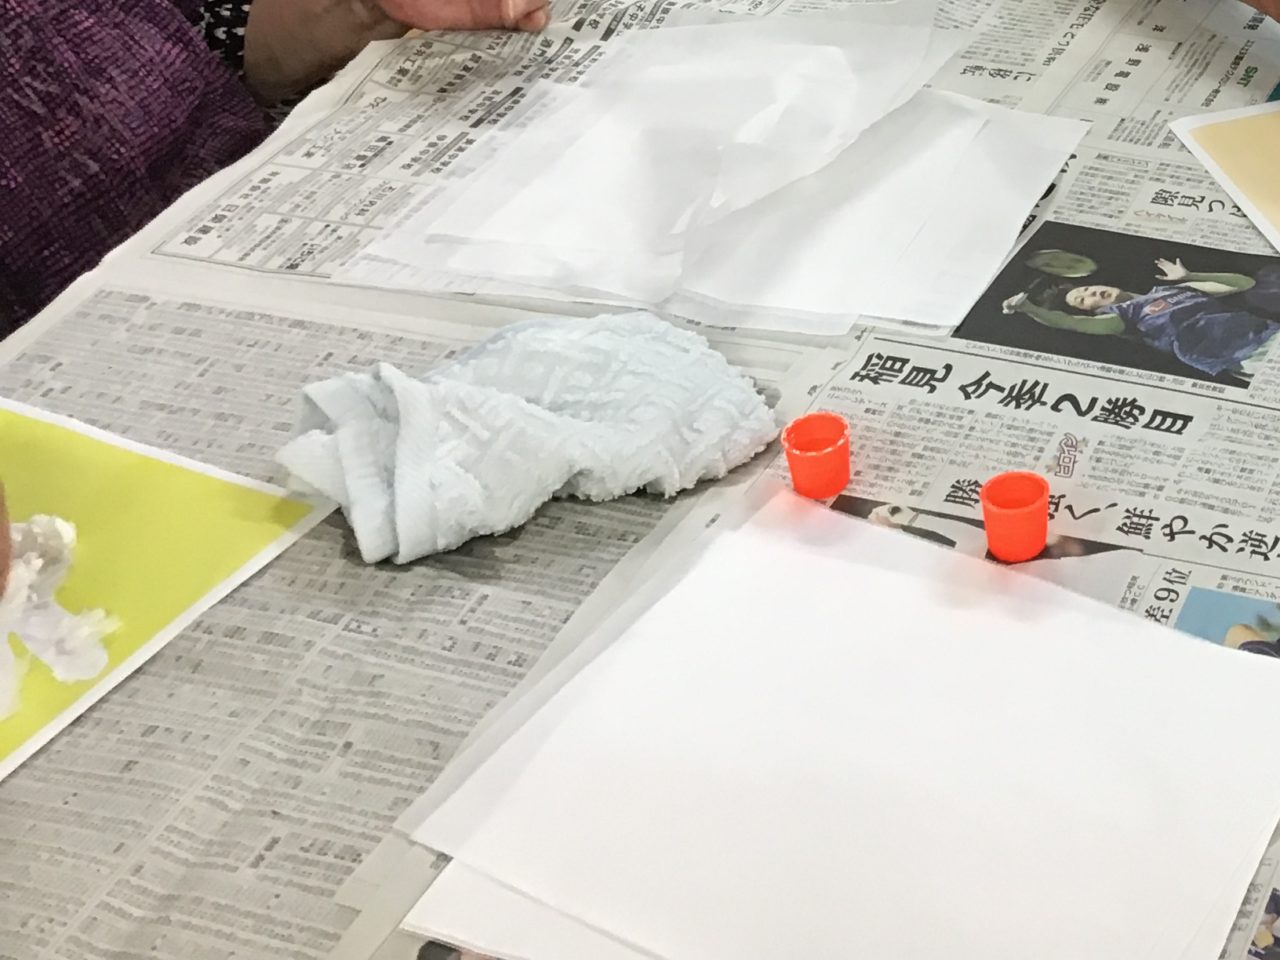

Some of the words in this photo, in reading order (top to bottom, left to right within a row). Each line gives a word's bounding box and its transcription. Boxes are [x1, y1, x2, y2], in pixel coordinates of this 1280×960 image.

[1236, 66, 1259, 89] SNT
[849, 351, 954, 395] 稲見
[957, 369, 1194, 435] 今季2勝目
[1144, 567, 1193, 626] 差9位
